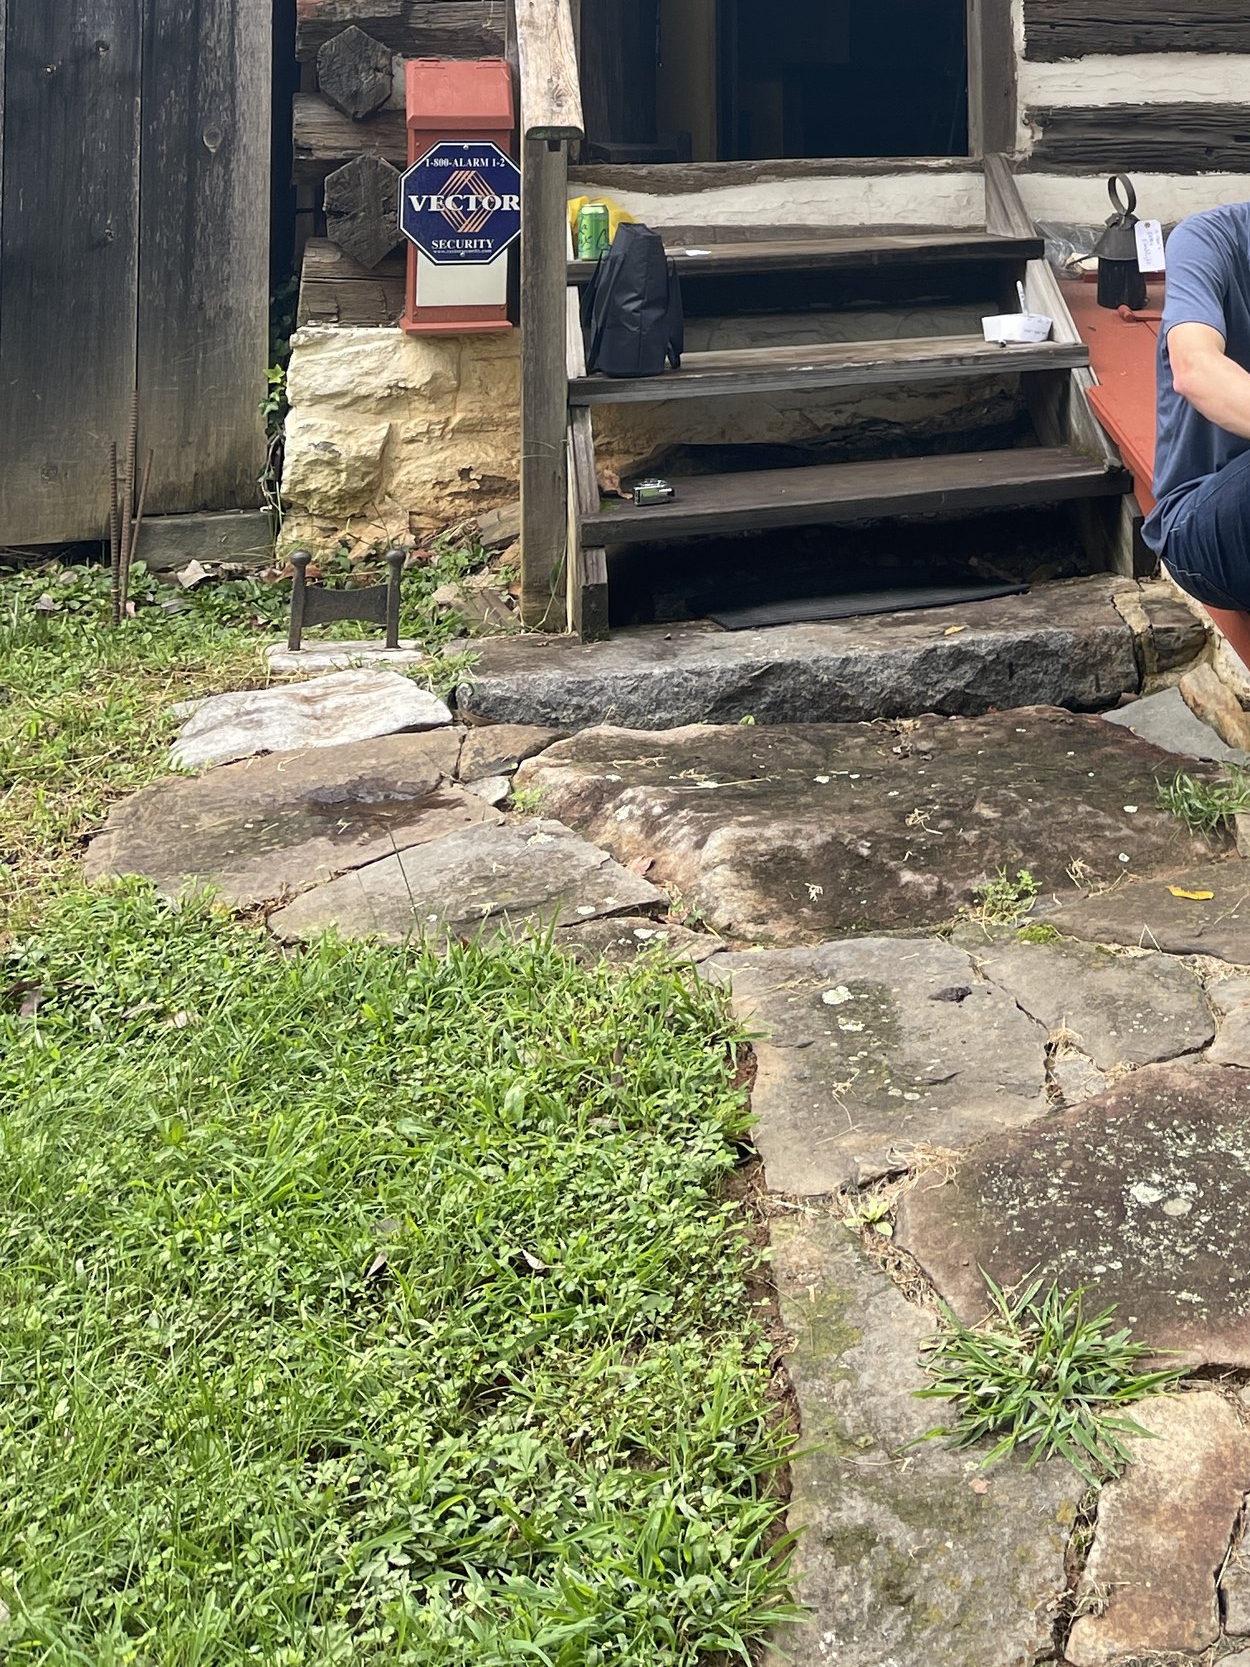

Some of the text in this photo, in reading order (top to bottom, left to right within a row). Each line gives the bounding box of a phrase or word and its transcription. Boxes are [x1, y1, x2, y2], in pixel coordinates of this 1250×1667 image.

[425, 157, 505, 168] 1-800-ALARM 1-2
[408, 194, 520, 212] VECTOR
[431, 238, 494, 249] SECURITY
